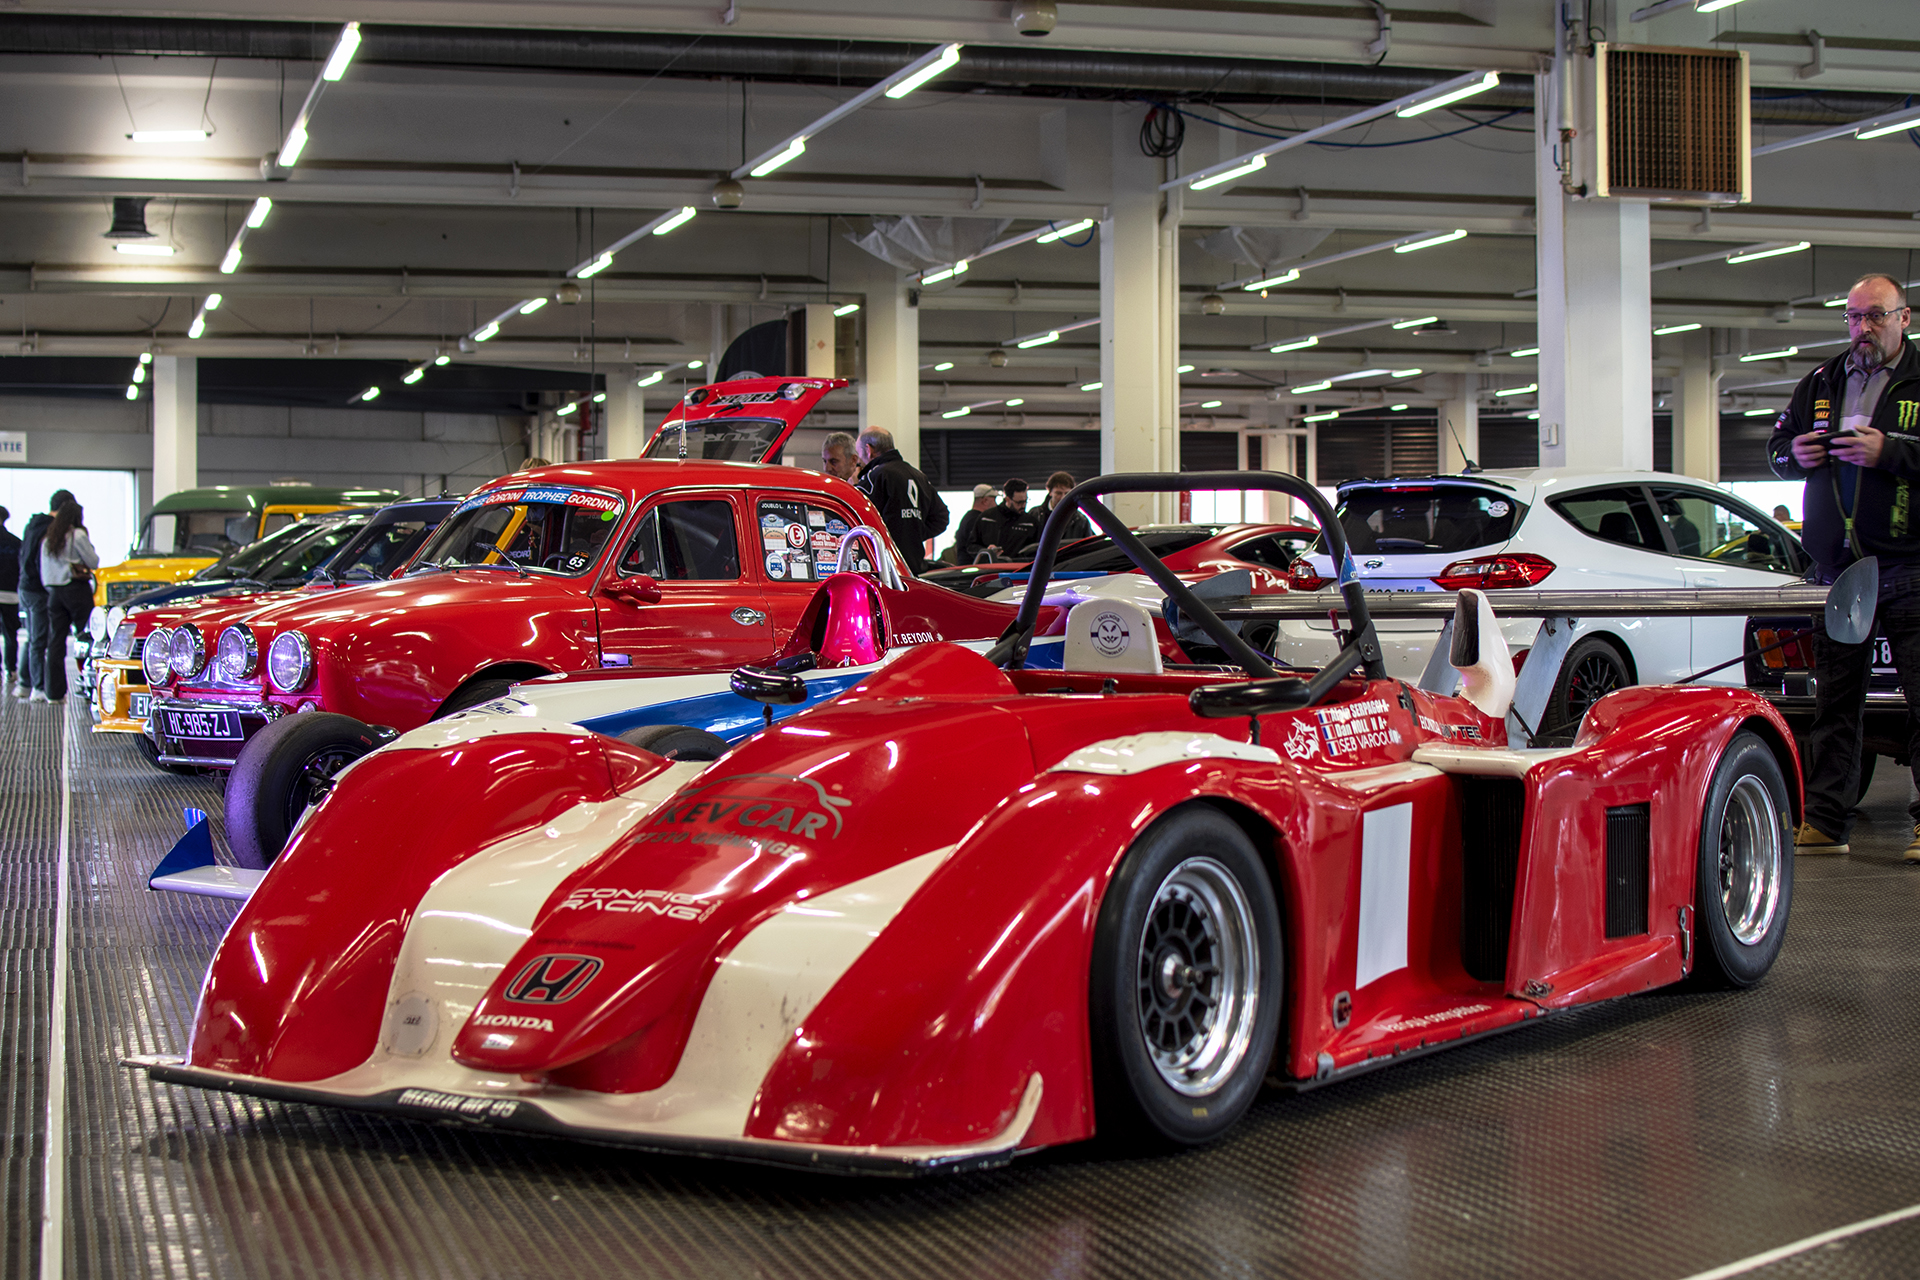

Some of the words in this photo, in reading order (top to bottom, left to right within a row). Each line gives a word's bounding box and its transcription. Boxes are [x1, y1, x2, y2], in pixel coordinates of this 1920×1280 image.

[0, 441, 22, 453] TIE
[485, 491, 523, 504] GORDINI
[522, 491, 569, 503] TROPHEE
[567, 494, 614, 510] GORDINI
[793, 527, 802, 540] E
[568, 557, 586, 568] 65
[893, 632, 934, 645] T.BEYDON
[1334, 723, 1353, 738] Dan
[1378, 715, 1387, 730] A+
[1339, 736, 1358, 753] SEB
[654, 802, 741, 827] KEV
[738, 803, 828, 840] CAR
[691, 830, 801, 857] GUÉNANGE
[562, 899, 703, 921] RACING
[473, 1014, 554, 1033] HONDA
[397, 1088, 466, 1110] MERLIN
[459, 1096, 494, 1114] MP
[489, 1100, 520, 1118] 95
